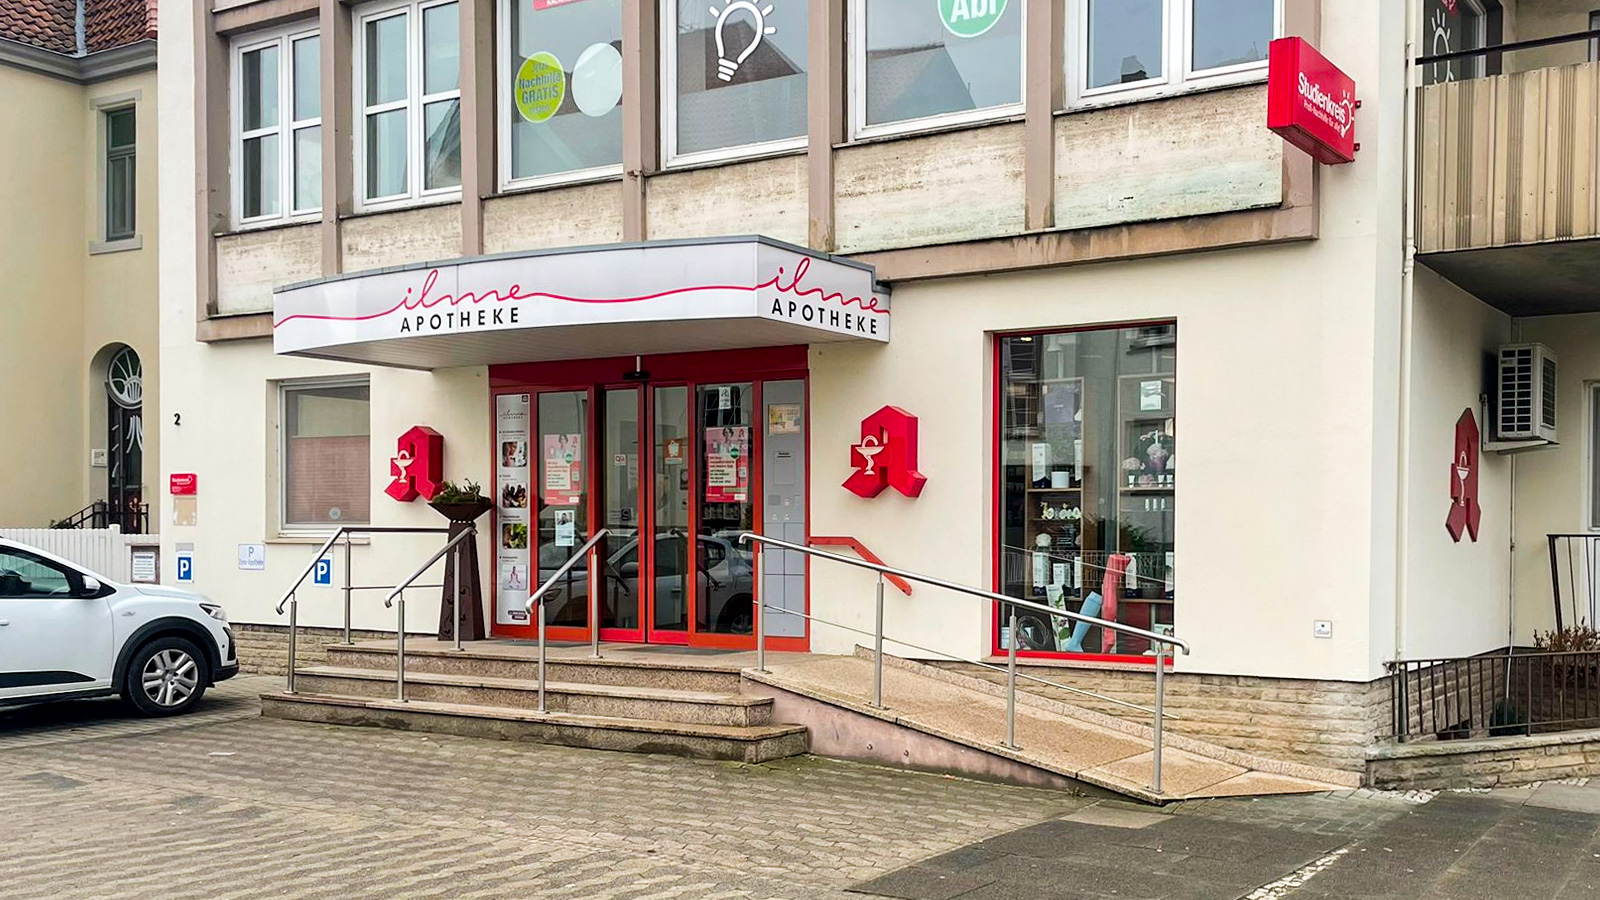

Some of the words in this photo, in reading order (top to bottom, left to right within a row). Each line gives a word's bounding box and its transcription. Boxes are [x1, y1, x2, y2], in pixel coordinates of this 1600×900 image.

[519, 71, 561, 89] Nachhilfe
[522, 84, 559, 104] GRATIS
[1298, 72, 1346, 124] Studienkreis
[404, 269, 520, 310] ilme
[774, 257, 888, 315] ilme
[400, 306, 519, 333] APOTHEKE
[771, 298, 877, 335] APOTHEKE
[173, 413, 181, 426] 2
[249, 546, 255, 558] P
[180, 559, 189, 578] P
[317, 561, 328, 581] P
